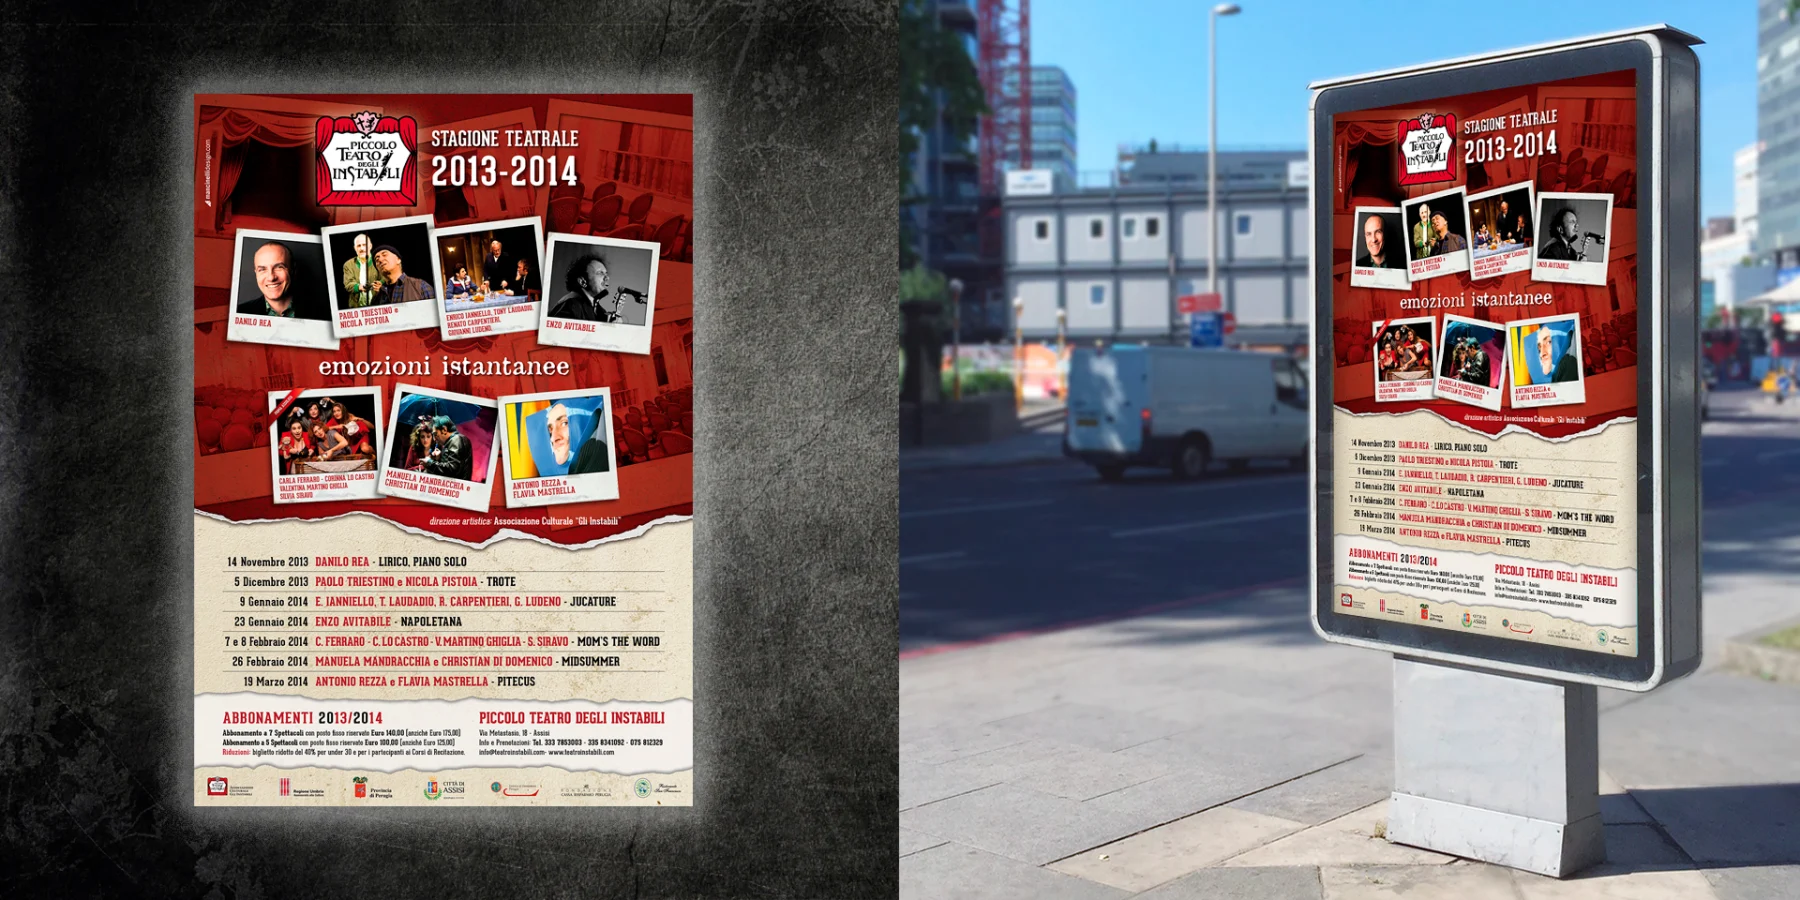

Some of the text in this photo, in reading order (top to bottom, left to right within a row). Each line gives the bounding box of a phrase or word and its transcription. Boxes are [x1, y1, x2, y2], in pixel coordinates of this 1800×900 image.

[1464, 108, 1558, 135] STAGIONE TEATRALE
[431, 129, 579, 148] STAGIONE TEATRALE
[1417, 132, 1445, 143] PICCOLO
[350, 140, 397, 150] PICCOLO
[1409, 138, 1436, 153] TEATRO
[1464, 128, 1557, 165] 2013-2014
[336, 147, 382, 162] TEATRO
[431, 155, 577, 187] 2013-2014
[1400, 288, 1552, 309] emozioni istantanee
[339, 306, 393, 320] PAOLO TRIESTINO
[446, 312, 465, 322] ENRICO
[234, 316, 272, 327] DANILO REA
[340, 315, 390, 329] NICOLA PISTOIA
[447, 320, 467, 329] RENATO
[546, 320, 596, 333] ENZO AVITABILE
[318, 355, 569, 376] emozioni istantanee
[385, 470, 464, 491] MANUELA MANDRACCHIA
[512, 479, 561, 490] ANTONIO REZZA
[385, 478, 460, 499] CHRISTIAN DI DOMENICO
[513, 486, 576, 499] FLAVIA MASTRELLA
[429, 516, 461, 526] direzione
[493, 516, 540, 525] Associazione
[541, 516, 574, 526] Culturale
[227, 556, 467, 567] 14 Novembre 2013 DANILO REA LIRICO, PIANO SOLO
[1349, 547, 1438, 567] ABBONAMENTI 2013/2014
[234, 576, 516, 587] 5 Dicembre 2013 PAOLO TRIESTINO NICOLA PISTOIA TROTE
[1495, 563, 1618, 588] PICCOLO TEATRO DEGLI INSTABILI
[240, 596, 617, 607] 9 Gennaio 2014 E. IANNIELLO, T. LAUDADIO, R. CARPENTIERI, G. LUDENO JUCATURE
[234, 616, 462, 627] 23 Gennaio 2014 ENZO AVITABILE NAPOLETANA
[224, 636, 660, 647] 7 8 Febbraio 2014 C. FERRARO C. LO CASTRO V. MARTINO GHIGLIA S. SIRAVO MOM'S THE WORD
[232, 656, 620, 667] 26 Febbraio 2014 MANUELA MANDRACCHIA CHRISTIAN DI DOMENICO MIDSUMMER
[244, 676, 536, 687] 19 Marzo 2014 ANTONIO REZZA FLAVIA MASTRELLA PITECUS
[223, 711, 383, 724] ABBONAMENTI 2013/2014
[479, 711, 665, 724] PICCOLO TEATRO DEGLI INSTABILI
[479, 729, 488, 737] Via
[533, 729, 550, 737] Assisi
[532, 738, 663, 746] Tel. 333 7853003 335 8341092 075 812329
